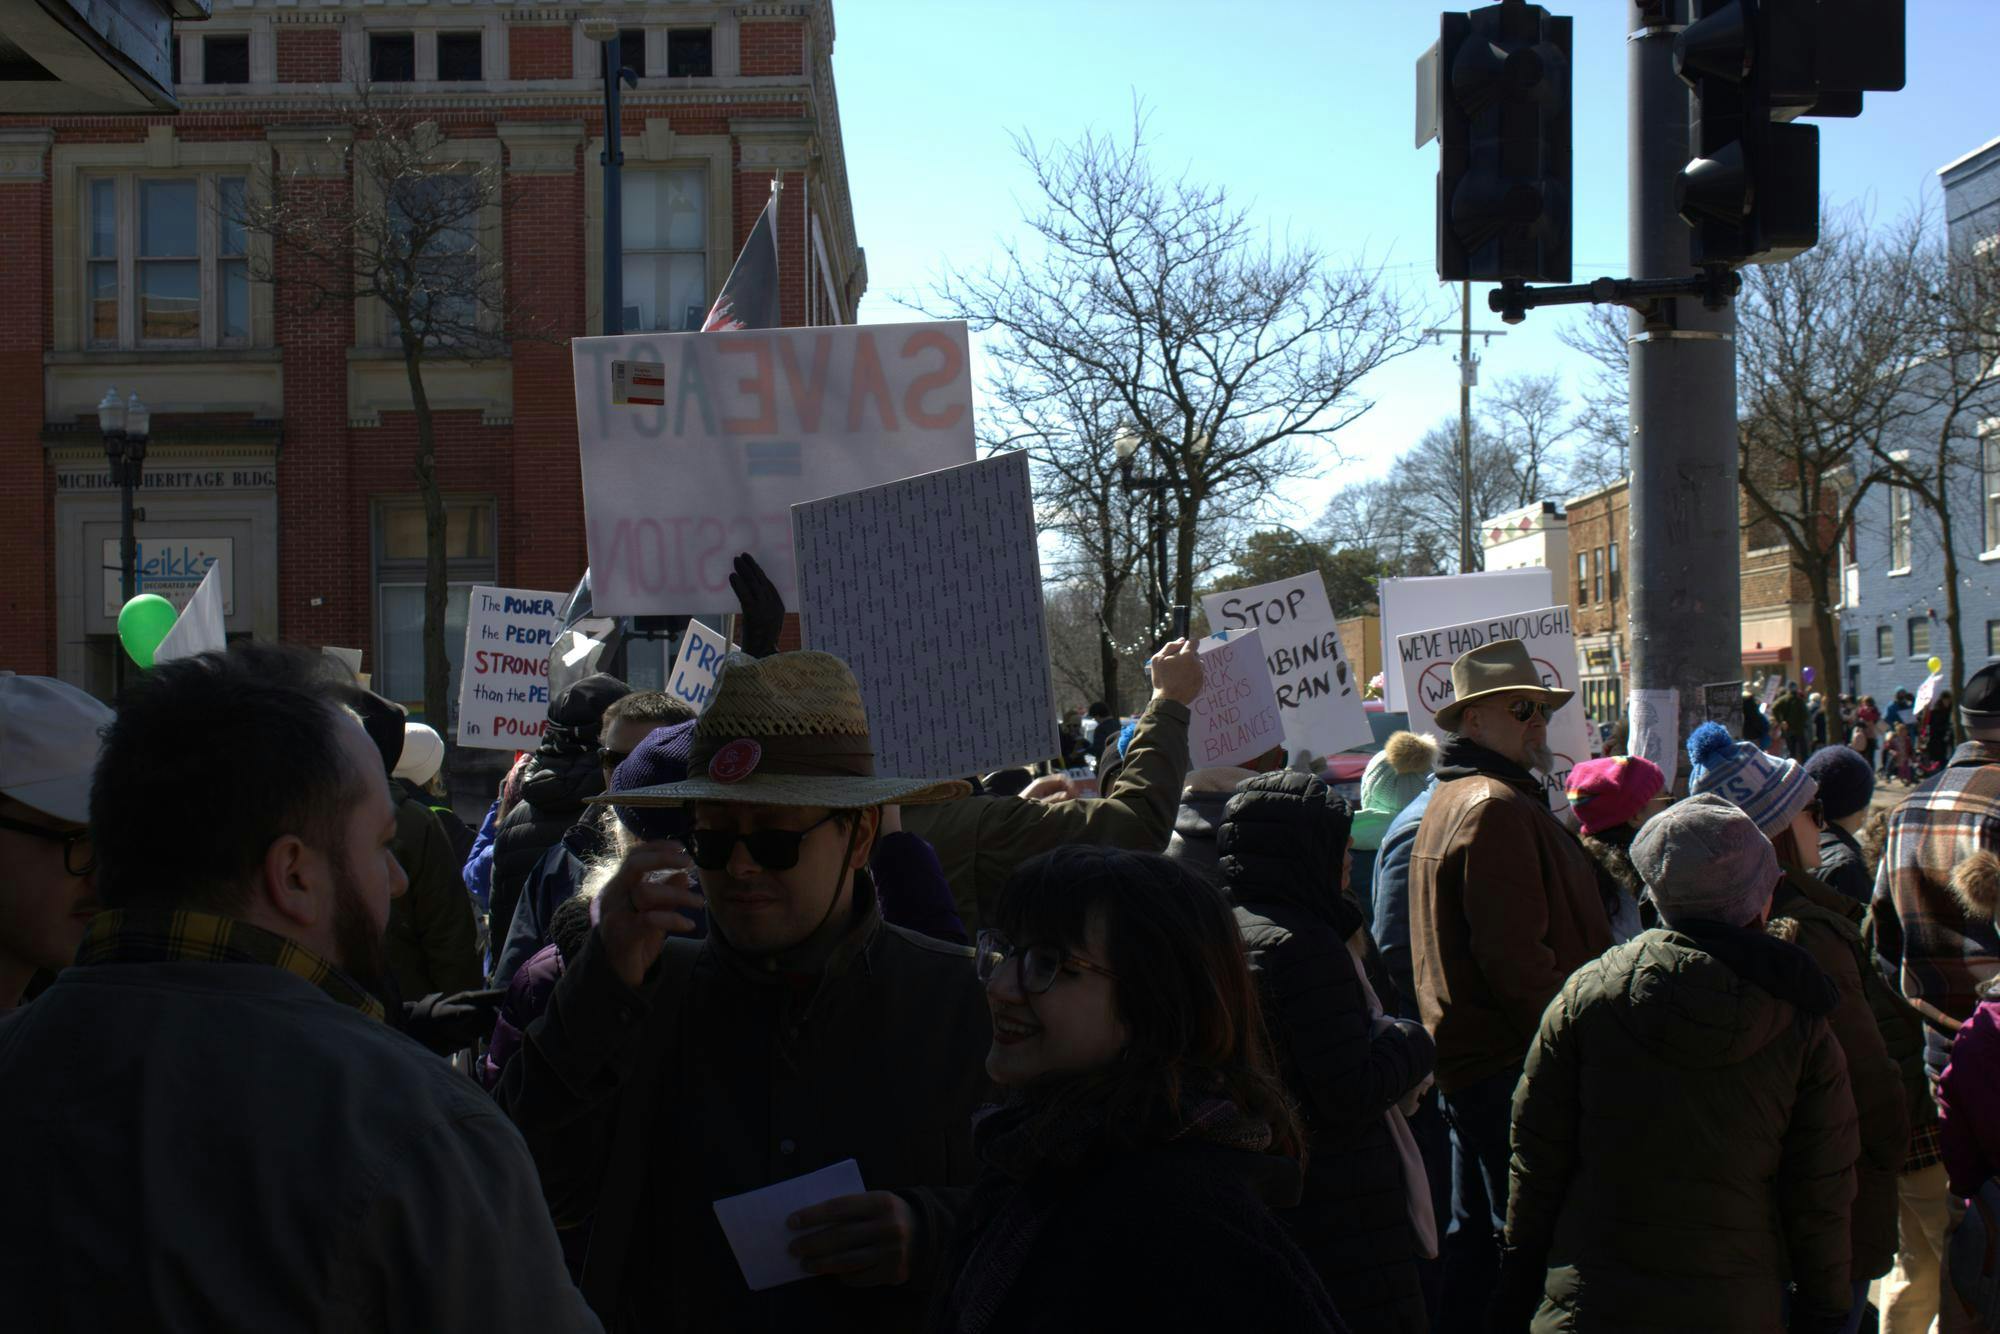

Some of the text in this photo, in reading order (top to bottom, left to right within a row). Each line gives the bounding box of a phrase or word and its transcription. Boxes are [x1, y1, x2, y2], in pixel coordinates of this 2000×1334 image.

[58, 471, 276, 488] MICHIG HERITAGE BLDG.
[481, 594, 555, 616] The POWER
[1222, 588, 1305, 631] STOP
[482, 625, 559, 645] the PEOPL
[1399, 610, 1569, 662] WE'VE HAD ENOUGH!
[474, 651, 550, 677] STRONG
[1266, 631, 1338, 676] BING
[473, 683, 548, 703] than the PE
[1203, 665, 1233, 695] ACK
[1274, 660, 1351, 710] RAN!
[1426, 679, 1454, 703] WA
[1195, 678, 1251, 716] CHECKS
[467, 721, 480, 735] in
[1209, 706, 1241, 732] AND
[1204, 705, 1276, 762] BALANCES
